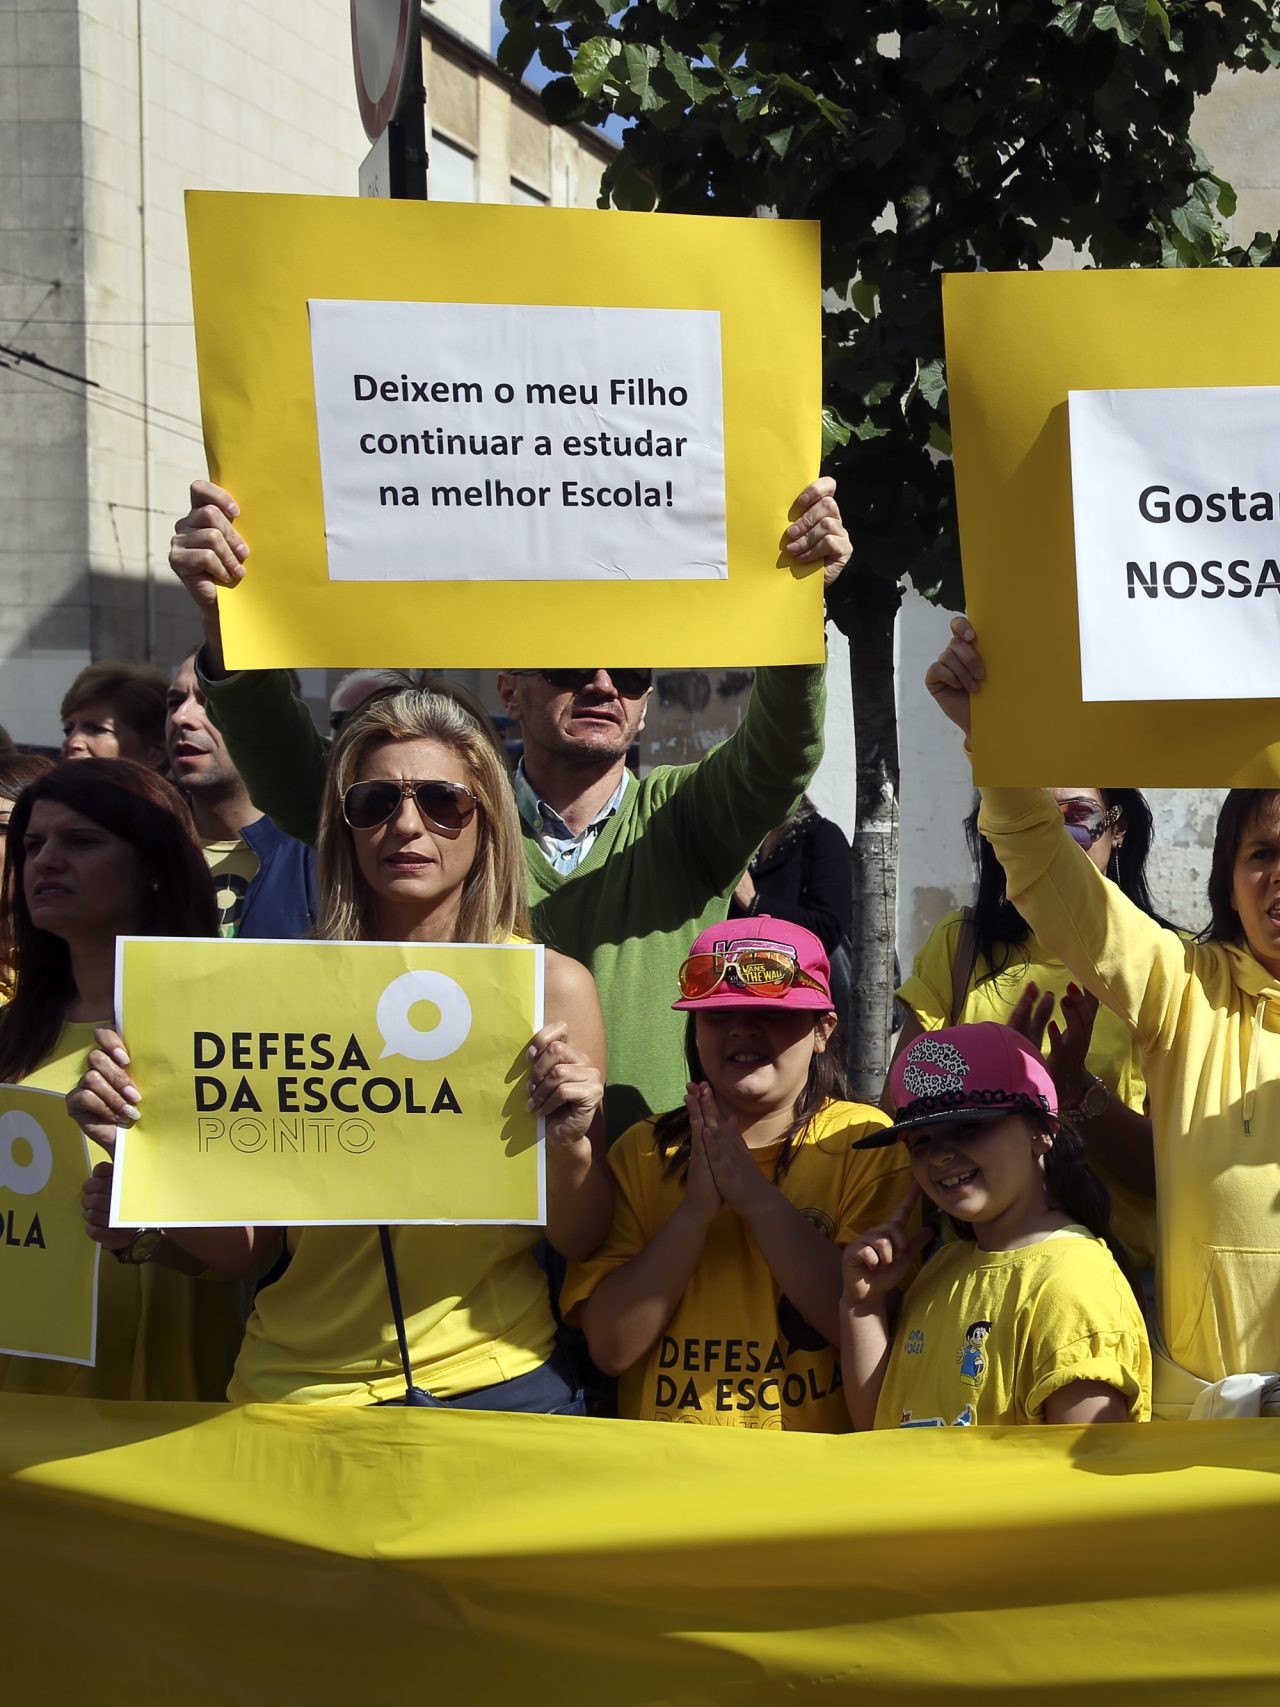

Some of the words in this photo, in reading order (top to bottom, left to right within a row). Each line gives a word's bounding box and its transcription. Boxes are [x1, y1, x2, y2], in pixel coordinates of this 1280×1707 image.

[354, 374, 482, 402] Deixem
[495, 384, 514, 403] o
[527, 384, 597, 404] meu
[611, 378, 687, 406] Filho
[360, 428, 523, 455] continuar
[535, 436, 551, 455] a
[564, 430, 687, 457] estudar
[380, 486, 419, 506] na
[432, 479, 550, 506] melhor
[562, 480, 672, 507] Escola!
[741, 964, 765, 973] VANS
[746, 972, 764, 982] THE
[194, 1032, 370, 1070] DEFESA
[195, 1076, 262, 1112] DA
[278, 1077, 462, 1113] ESCOLA
[197, 1117, 376, 1154] PONTO
[0, 1211, 45, 1248] LA
[658, 1336, 786, 1374] DEFESA
[655, 1374, 702, 1410] DA
[715, 1360, 842, 1411] ESCOLA
